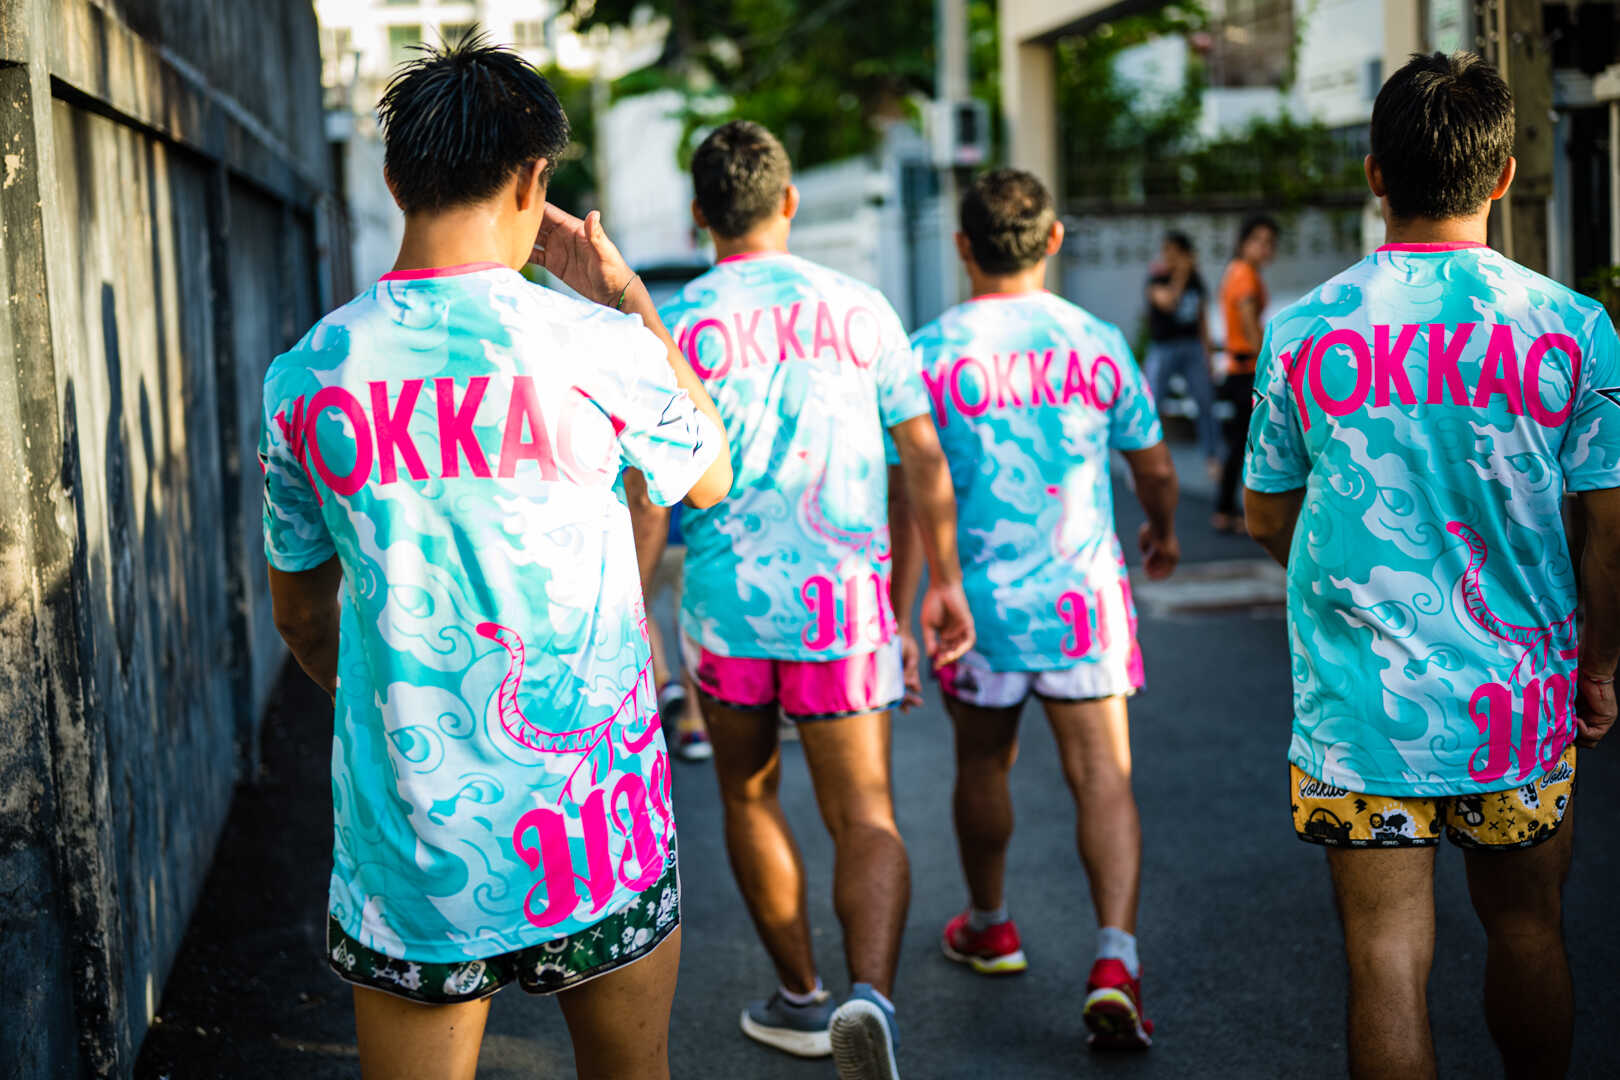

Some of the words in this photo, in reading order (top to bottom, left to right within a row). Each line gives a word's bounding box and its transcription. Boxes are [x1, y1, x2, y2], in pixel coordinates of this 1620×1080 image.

[678, 300, 881, 381] OKKAO
[1279, 322, 1583, 433] YOKKAO
[921, 350, 1122, 428] YOKKAO
[272, 376, 622, 508] YOKKAO
